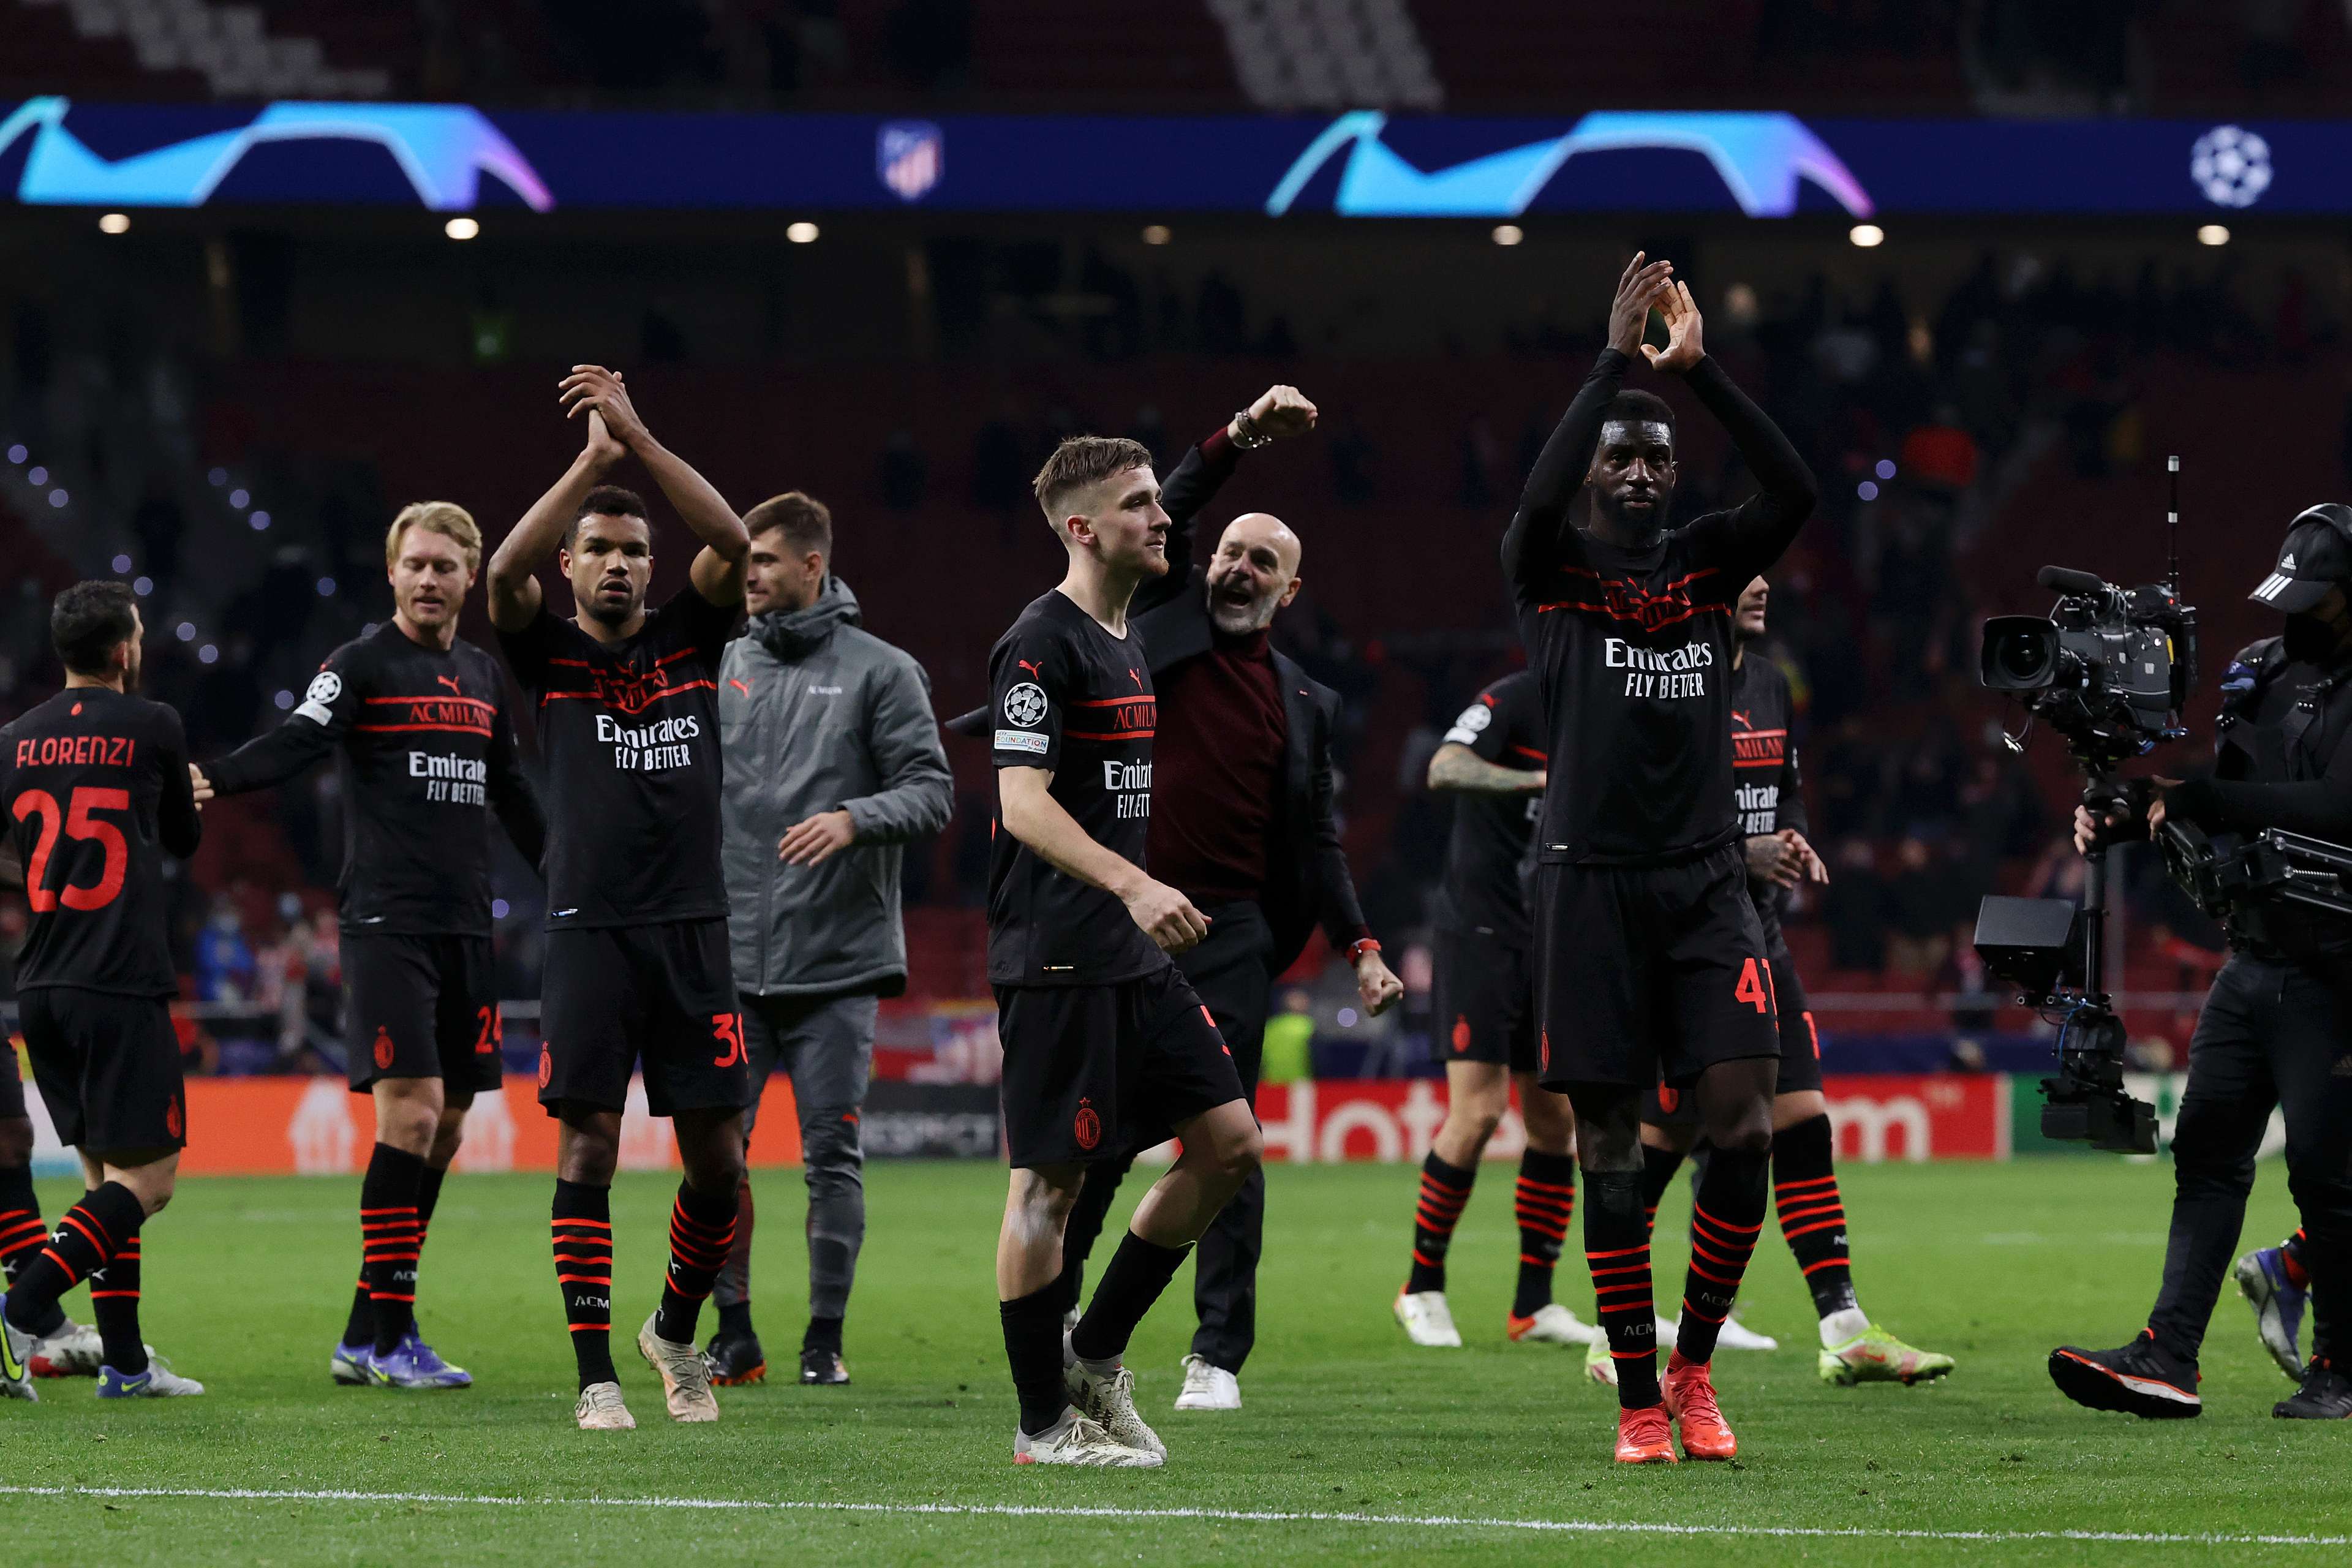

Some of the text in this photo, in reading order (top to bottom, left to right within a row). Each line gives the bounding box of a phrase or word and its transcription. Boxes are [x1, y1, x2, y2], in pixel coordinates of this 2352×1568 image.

[1604, 638, 1713, 672] Emirates
[1624, 673, 1654, 698] FLY
[1114, 704, 1156, 729] AC MILA
[595, 714, 699, 748] Emirates
[996, 736, 1047, 748] FOUNDATION
[15, 735, 135, 769] FLORENZI
[615, 744, 692, 771] FLY BETTER
[408, 751, 487, 785] Emirat
[1102, 758, 1152, 791] Emirat
[426, 780, 449, 802] FLY
[1117, 794, 1134, 819] FLY
[12, 786, 130, 914] 25
[575, 1295, 609, 1309] ACM
[1624, 1323, 1656, 1337] ACM
